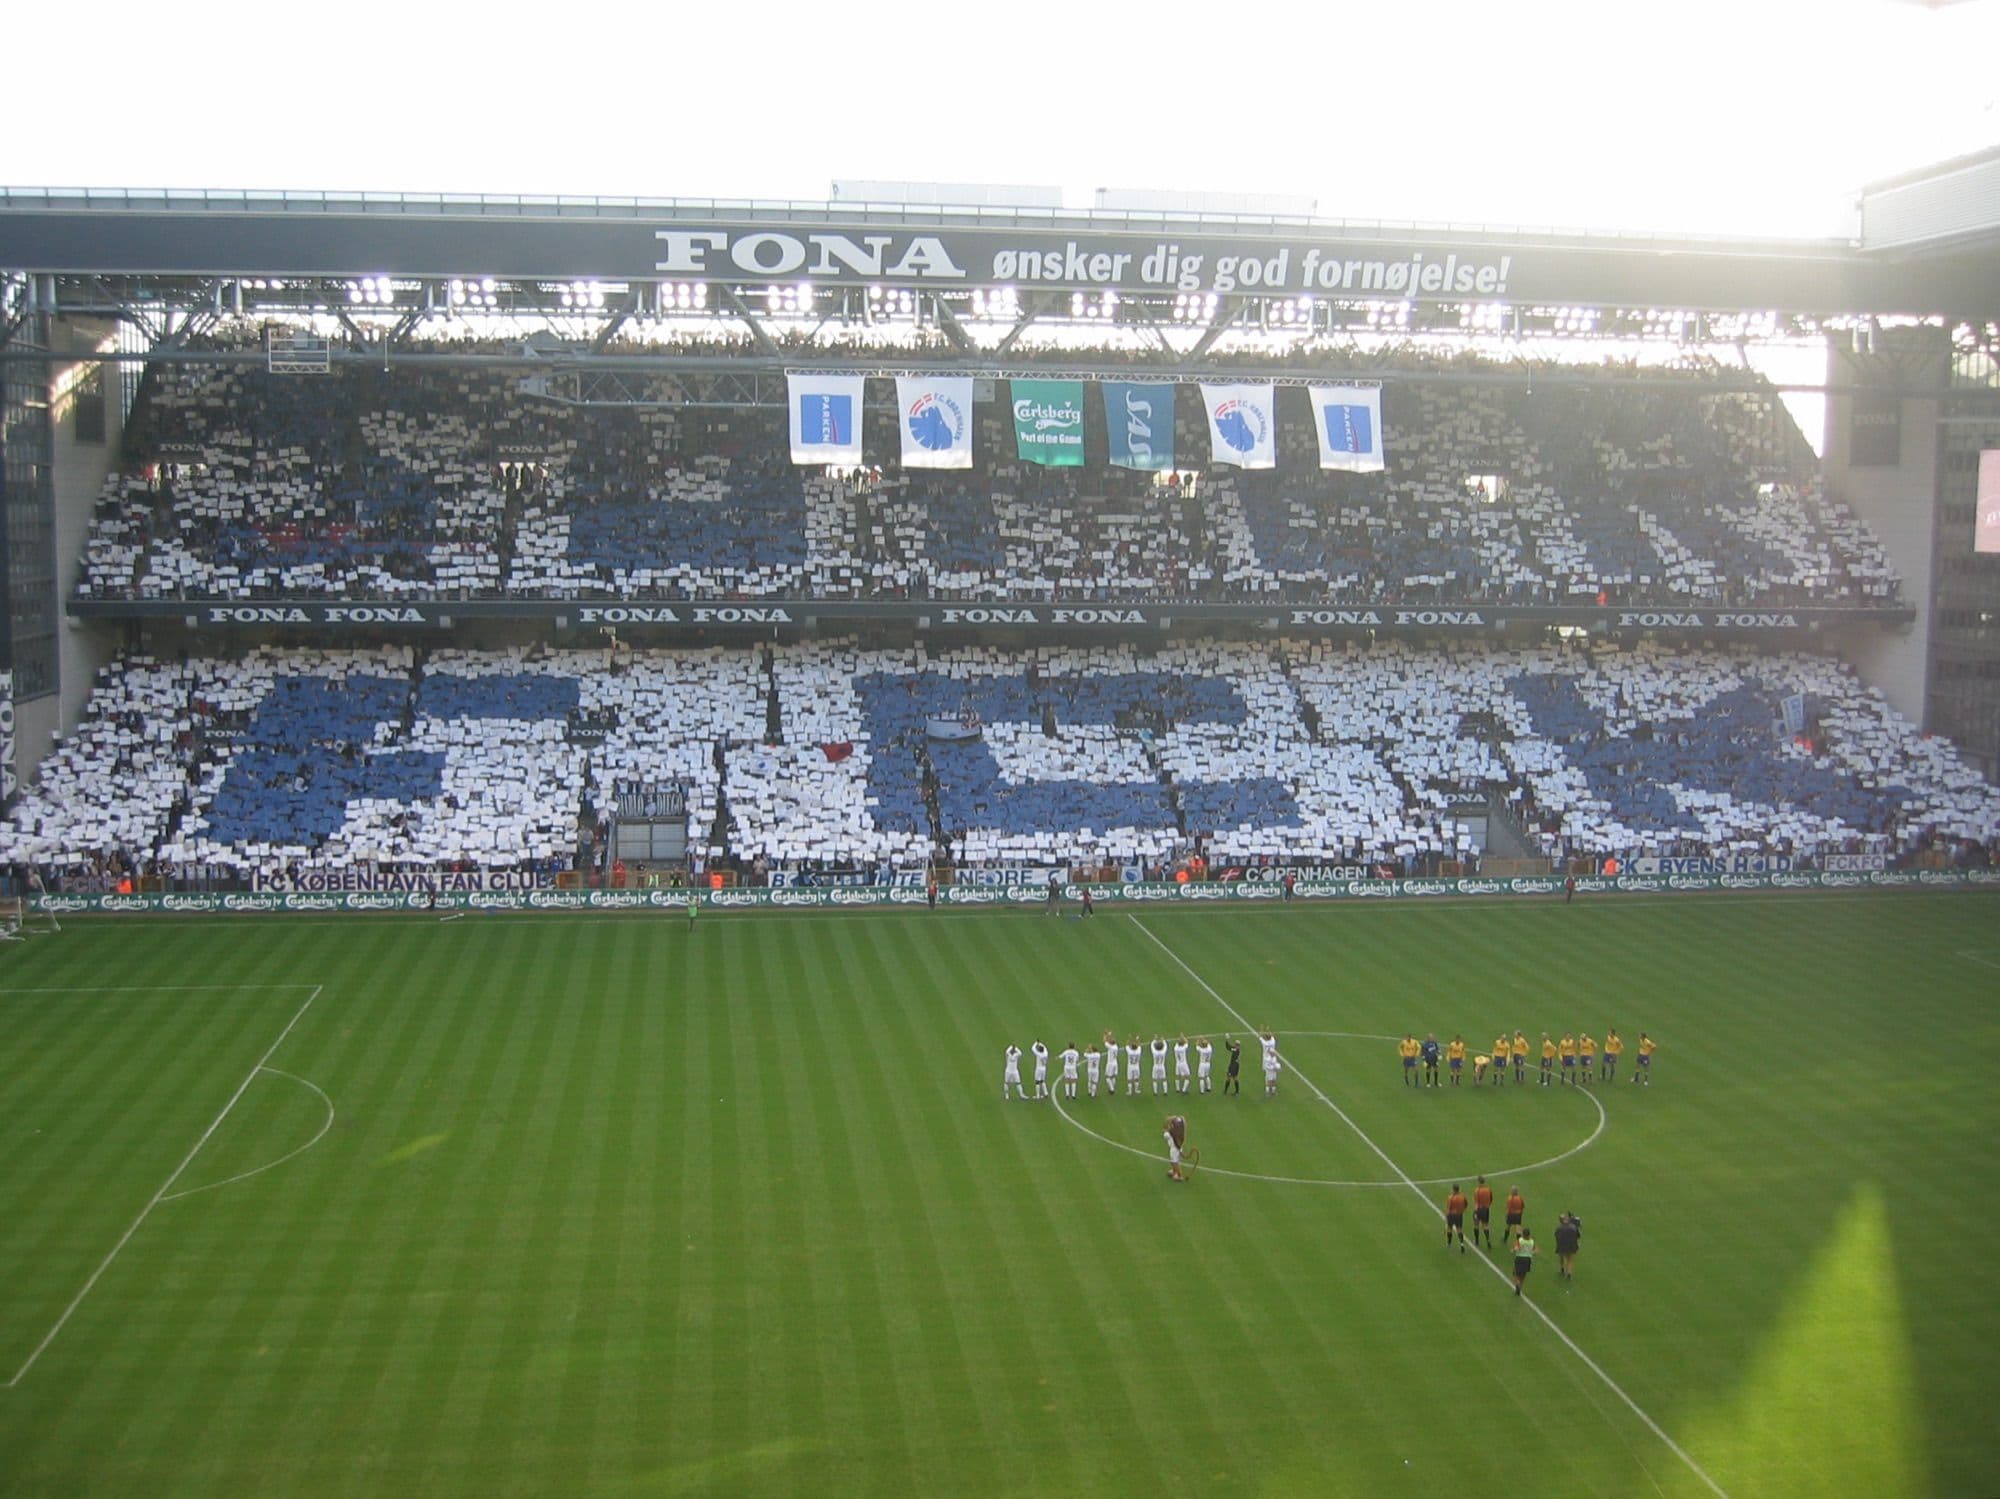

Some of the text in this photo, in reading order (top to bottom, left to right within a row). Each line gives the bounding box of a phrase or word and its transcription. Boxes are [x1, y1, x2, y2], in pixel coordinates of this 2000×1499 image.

[655, 231, 1511, 297] FONA ønsker dig god fornøjelse!
[822, 395, 830, 443] PARKEN
[1013, 399, 1081, 425] Carlsberg
[1126, 390, 1152, 463] SAS
[210, 608, 426, 622] FONA FONA
[580, 608, 792, 622] FONA FONA
[942, 609, 1147, 624] FONA FONA
[1290, 611, 1485, 625] FONA FONA
[1618, 613, 1798, 627] FONA FONA
[1443, 793, 1487, 803] ONA
[1659, 858, 1727, 874] BYENS
[258, 873, 286, 891] FC
[293, 873, 436, 891] KØBENHAVN
[441, 873, 483, 890] FAN
[1403, 878, 1446, 893] Carlsberg
[1458, 878, 1499, 892] Carlsberg
[1511, 877, 1553, 892] Carlsberg
[1617, 875, 1657, 889] Carlsberg
[1669, 874, 1708, 888] Carlsberg
[1720, 873, 1760, 887] Carlsberg
[1771, 872, 1810, 886] Carlsberg
[1821, 872, 1860, 886] Carlsberg
[1065, 886, 1111, 901] Carberg
[1180, 884, 1225, 899] Carlsberg
[1237, 883, 1280, 898] Carlsberg
[1293, 882, 1337, 896] Carlsberg
[1348, 879, 1393, 895] Carlsberg
[40, 895, 88, 909] Carlsberg
[101, 894, 149, 909] Carlsberg
[163, 894, 210, 909] Carlsberg
[224, 894, 272, 908] Carlsberg
[286, 893, 333, 908] Carlsberg
[347, 893, 394, 908] Carlsberg
[530, 892, 577, 907] Carlsberg
[591, 892, 638, 906] Carlsberg
[711, 890, 758, 905] Carlsberg
[771, 890, 818, 905] Carlsberg
[830, 890, 877, 904] Carlsberg
[890, 889, 928, 903] Carlsber
[949, 888, 995, 903] Carlsberg
